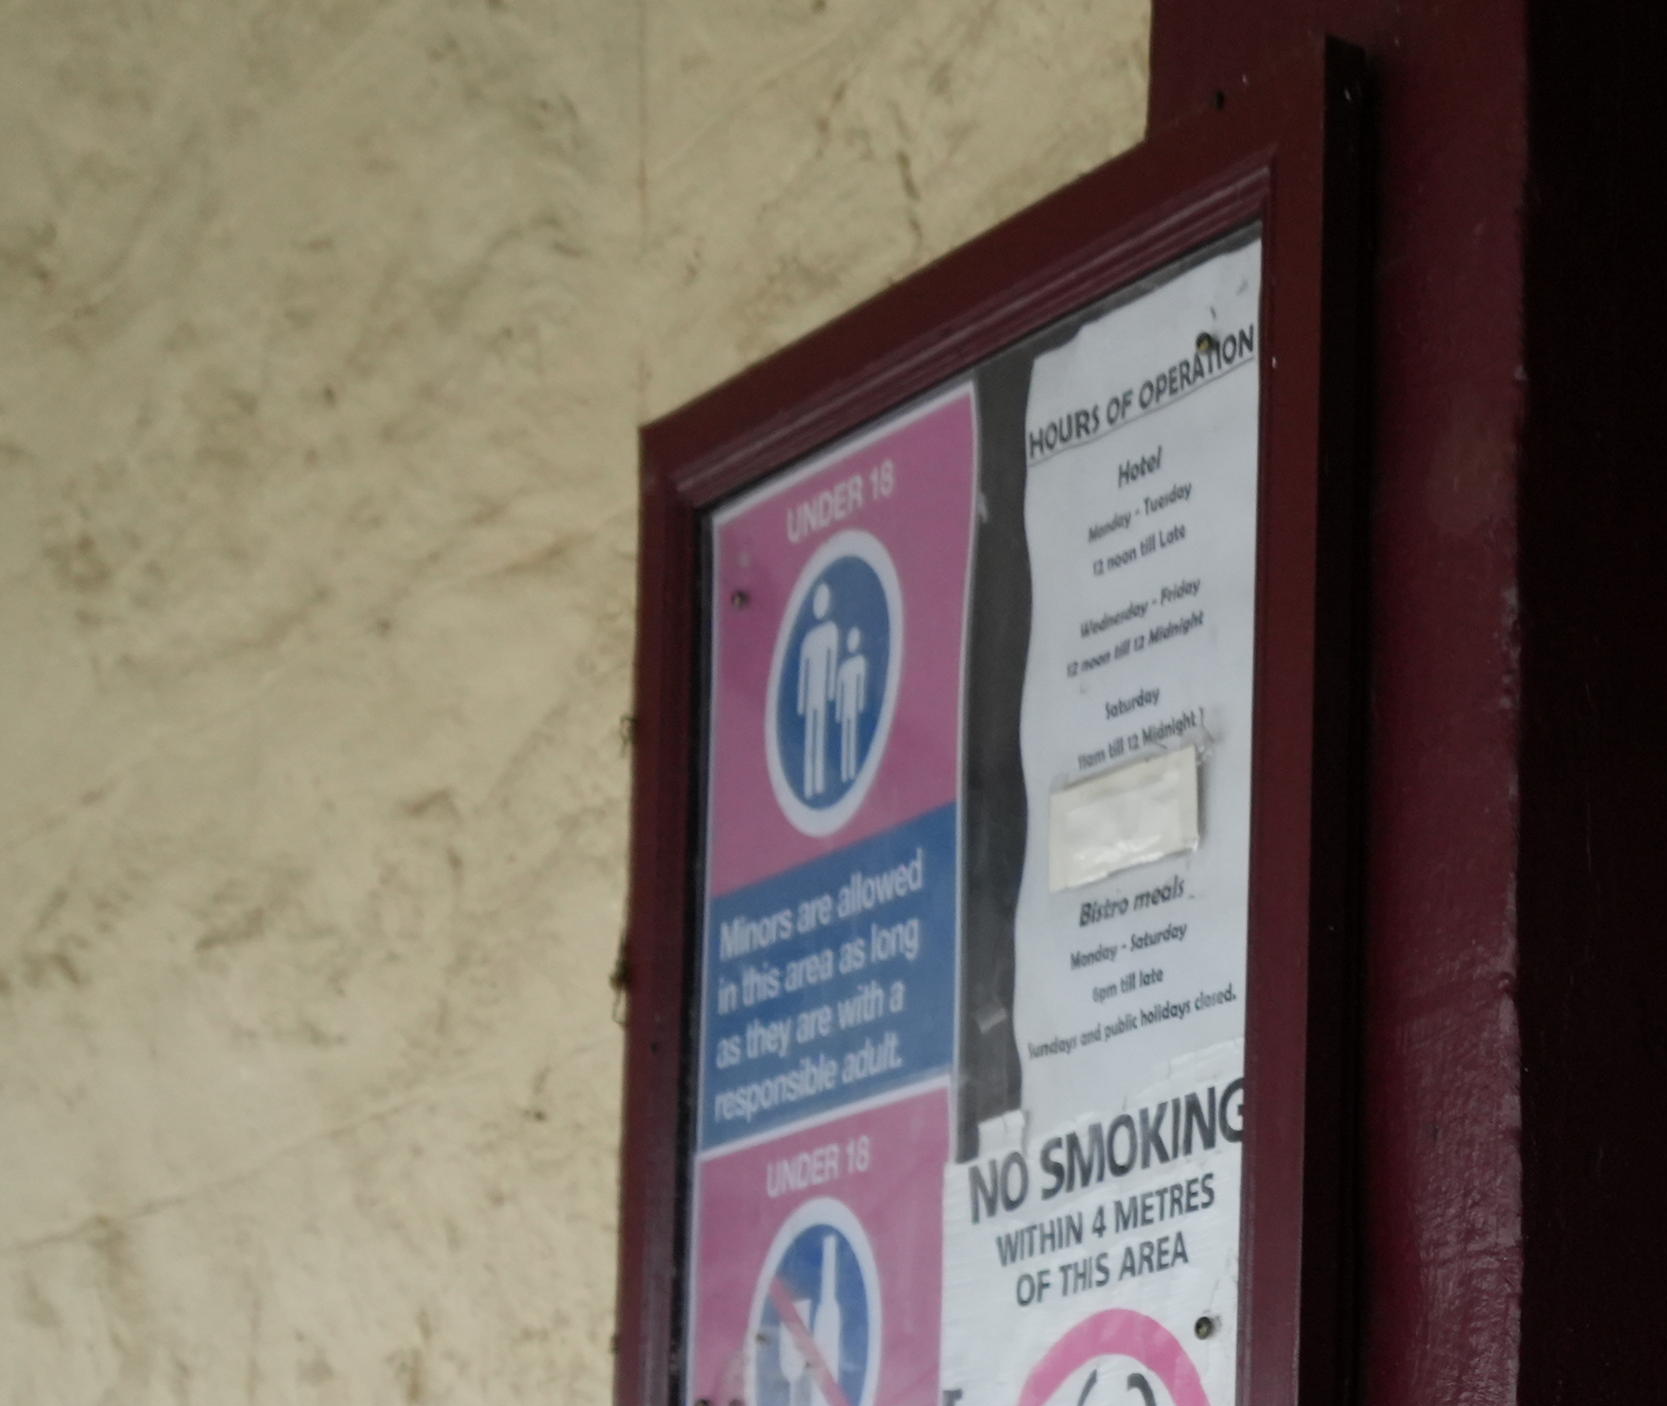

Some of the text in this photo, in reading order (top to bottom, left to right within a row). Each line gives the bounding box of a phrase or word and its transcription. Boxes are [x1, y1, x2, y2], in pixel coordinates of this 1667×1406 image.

[1028, 323, 1255, 459] HOURS OF OPERATION
[786, 458, 896, 543] UNDER 18
[1117, 444, 1163, 488] Hotel
[1088, 511, 1131, 544] Monday
[1143, 481, 1192, 516] Tuesday
[1092, 524, 1187, 577] 12 noon till Late
[1079, 600, 1149, 639] Wednesday
[1160, 578, 1202, 607] Friday
[1066, 609, 1205, 679] 12 noon till 12 Midnight
[1104, 687, 1161, 721] Saturday
[1108, 736, 1125, 760] till
[1127, 734, 1140, 753] 12
[1141, 709, 1197, 746] Midnight
[719, 848, 924, 961] Minors are allowed
[1078, 874, 1185, 928] Bistro meals
[717, 918, 919, 1015] in this area as long
[1069, 944, 1118, 971] Monday
[1130, 922, 1188, 952] Saturday
[1120, 971, 1136, 994] till
[1139, 967, 1164, 989] late
[716, 979, 905, 1070] as they are with a
[1027, 981, 1237, 1060] Sundays and public holidays closed.
[714, 1031, 903, 1123] responsible adult.
[766, 1135, 870, 1198] UNDER 18
[968, 1076, 1244, 1226] NO SMOKING
[996, 1172, 1216, 1268] WITHIN 4 METRES
[1016, 1230, 1189, 1307] OF THIS AREA
